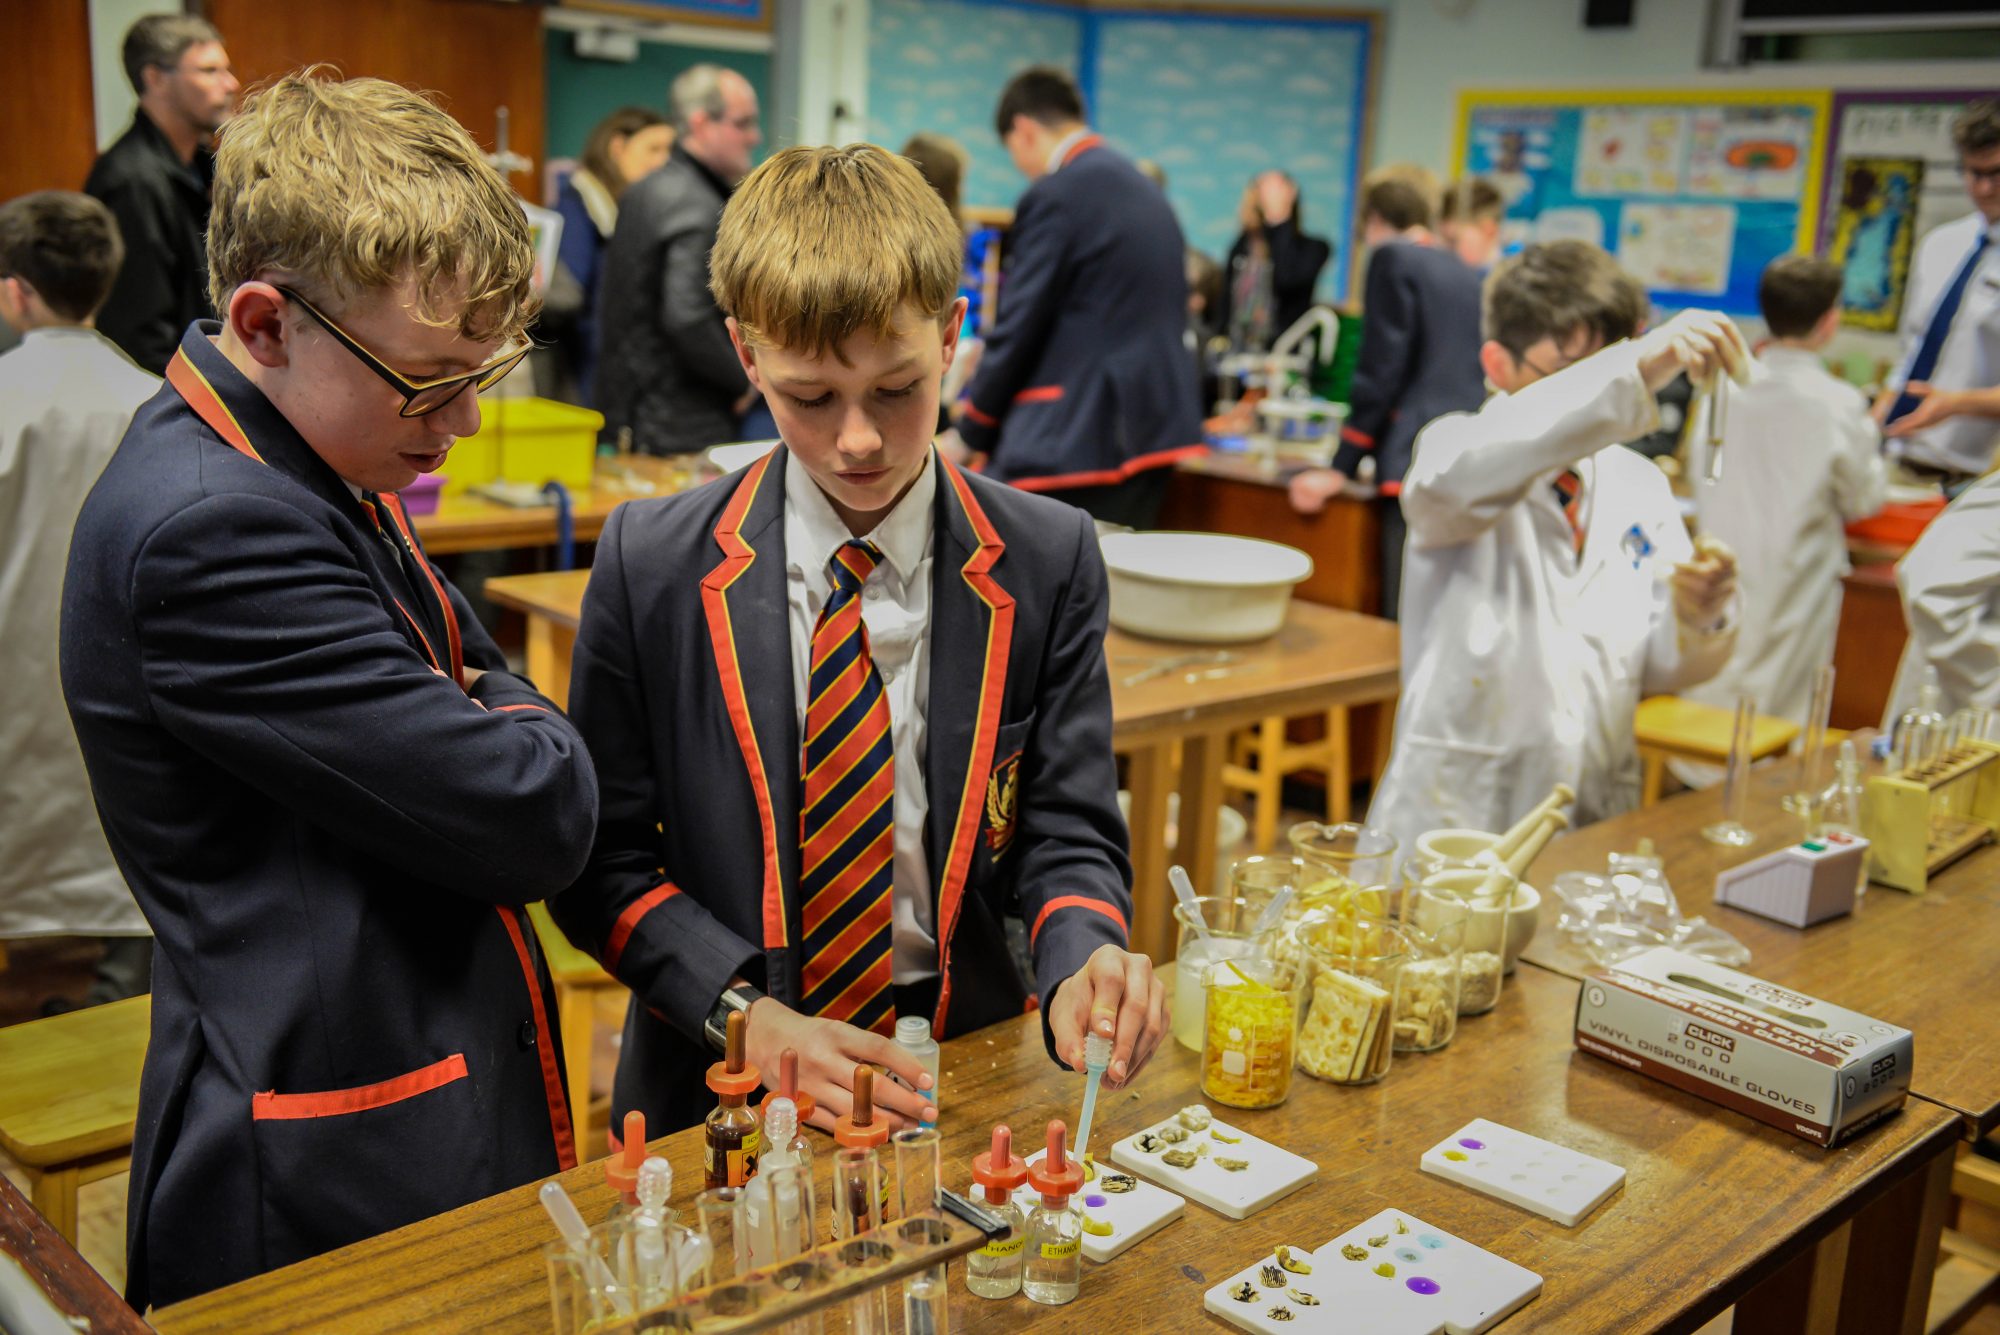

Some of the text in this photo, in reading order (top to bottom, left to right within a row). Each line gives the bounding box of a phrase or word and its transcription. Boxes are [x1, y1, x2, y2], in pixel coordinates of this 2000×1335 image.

[1687, 1024, 1732, 1050] CLICK
[1753, 1028, 1816, 1055] CLEAR
[1589, 1019, 1816, 1115] VINYL DISPOSABLE GLOVES
[1872, 1056, 1895, 1073] CLICK
